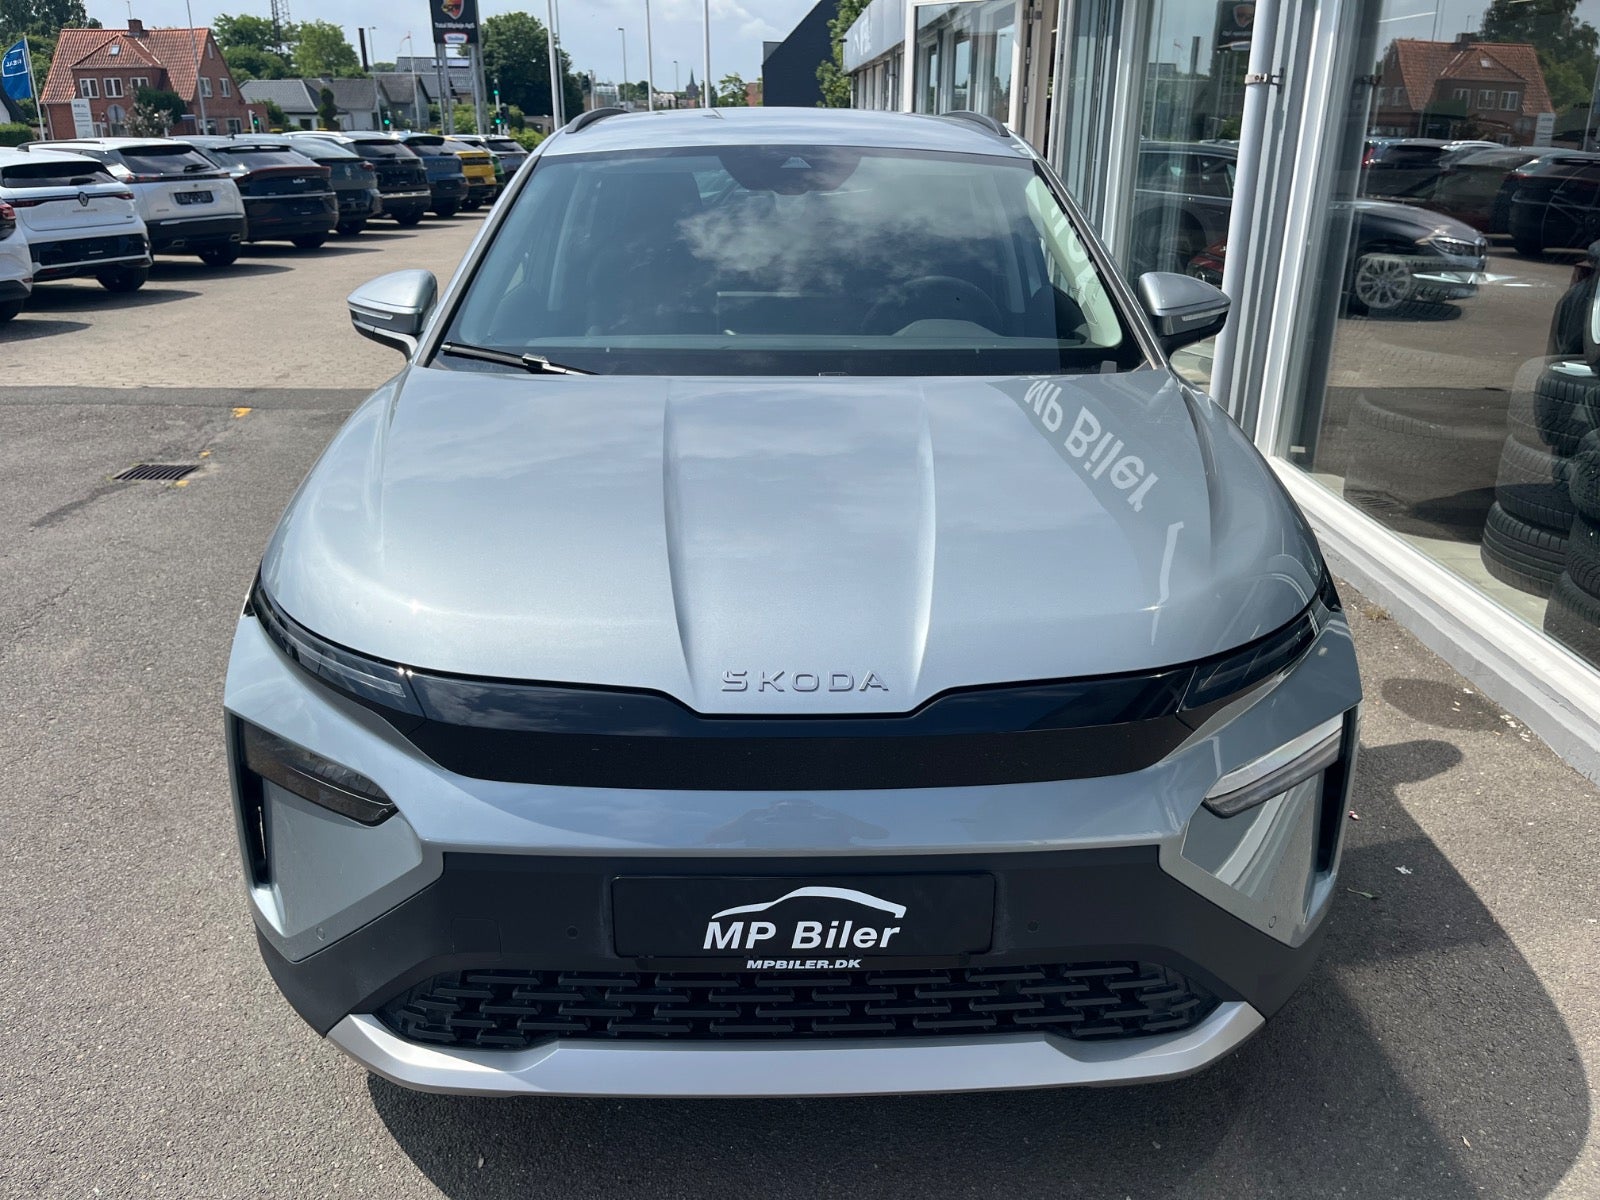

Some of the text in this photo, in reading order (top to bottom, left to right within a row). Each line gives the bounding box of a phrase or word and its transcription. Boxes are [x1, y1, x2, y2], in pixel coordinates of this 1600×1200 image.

[703, 920, 901, 949] MP Biler
[746, 959, 862, 969] MPBILER.DK
